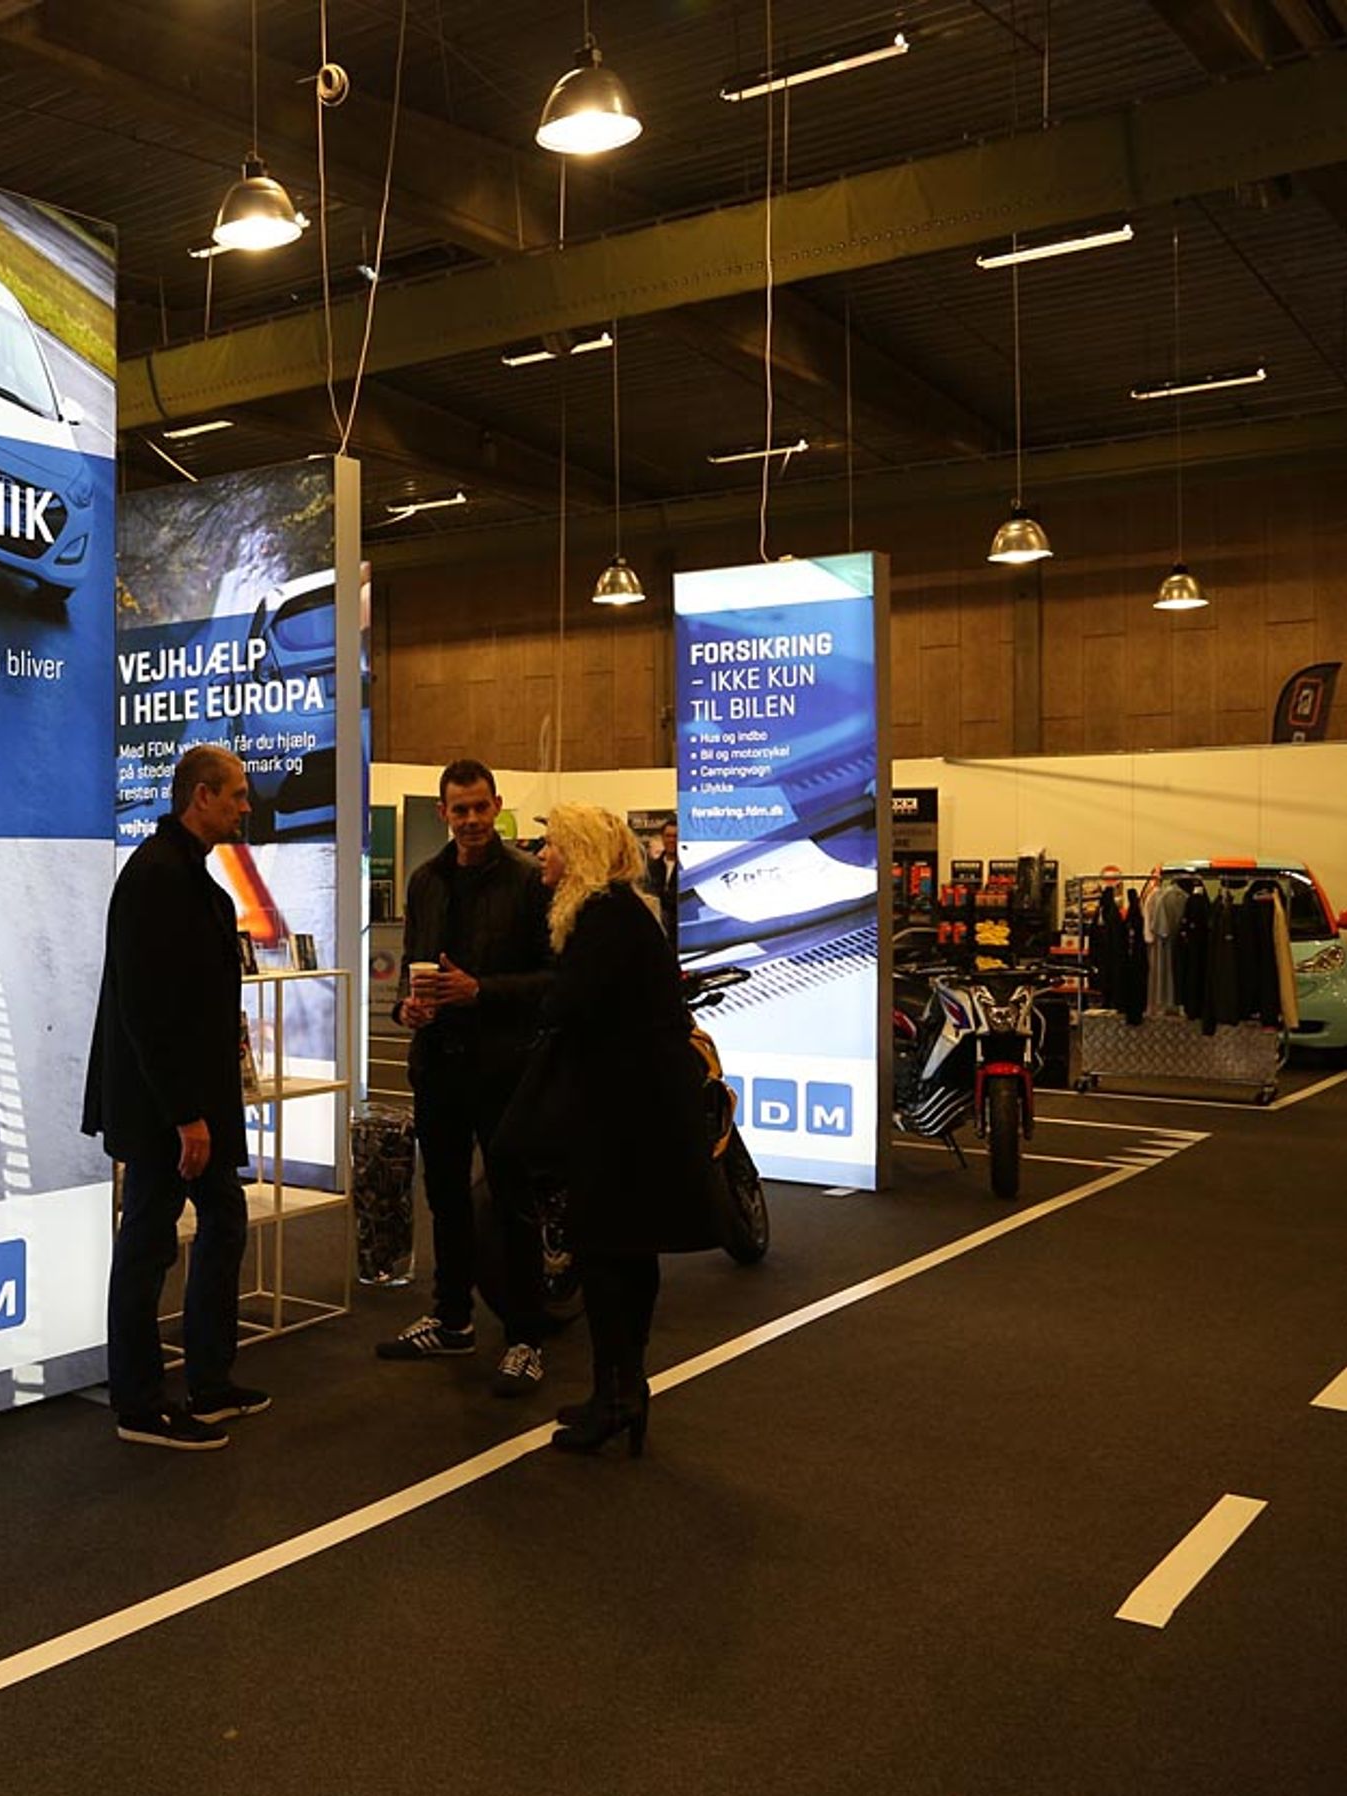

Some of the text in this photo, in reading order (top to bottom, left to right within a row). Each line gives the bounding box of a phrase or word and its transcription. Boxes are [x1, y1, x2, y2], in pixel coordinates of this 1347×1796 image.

[118, 638, 266, 684] VEJHJÆLP
[690, 632, 833, 665] FORSIKRING
[7, 649, 64, 680] bliver
[710, 667, 760, 692] IKKE
[768, 665, 815, 688] KUN
[120, 677, 324, 725] I HELE EUROPA
[690, 694, 795, 721] TIL BILEN
[119, 743, 144, 760] Med
[147, 741, 175, 758] FDM
[234, 734, 253, 752] får
[256, 734, 274, 750] du
[277, 731, 316, 753] hjælp
[700, 731, 768, 744] Hus og indbo
[700, 745, 790, 762] Bil og motorcykel
[119, 763, 134, 783] på
[286, 757, 303, 775] og
[700, 765, 771, 777] Campingvogn
